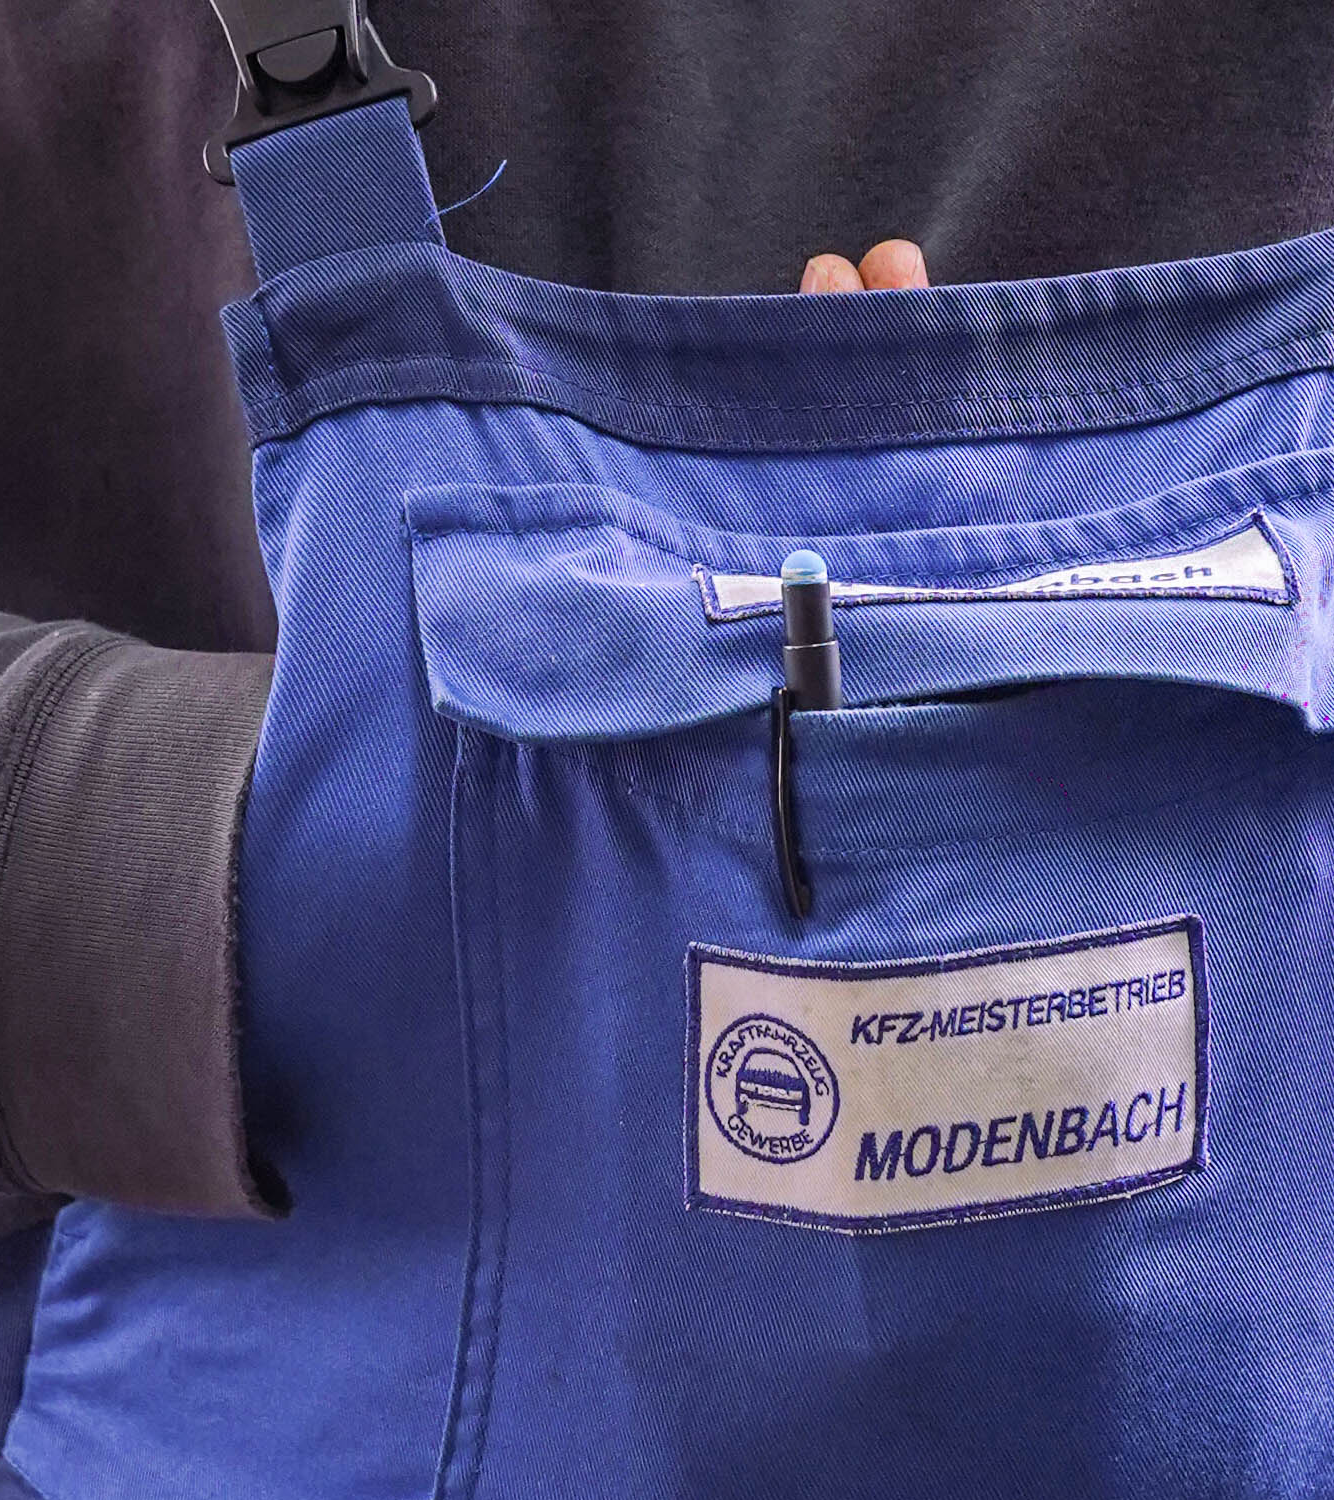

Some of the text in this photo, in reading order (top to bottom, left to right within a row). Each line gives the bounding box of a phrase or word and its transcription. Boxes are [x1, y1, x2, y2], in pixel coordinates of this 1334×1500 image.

[850, 970, 1186, 1045] KFZ-MEISTERBETRIEB
[716, 1024, 830, 1096] KRAFTFAHRZEUG
[727, 1113, 814, 1154] GEWERBE
[855, 1081, 1188, 1182] MODENBACH
